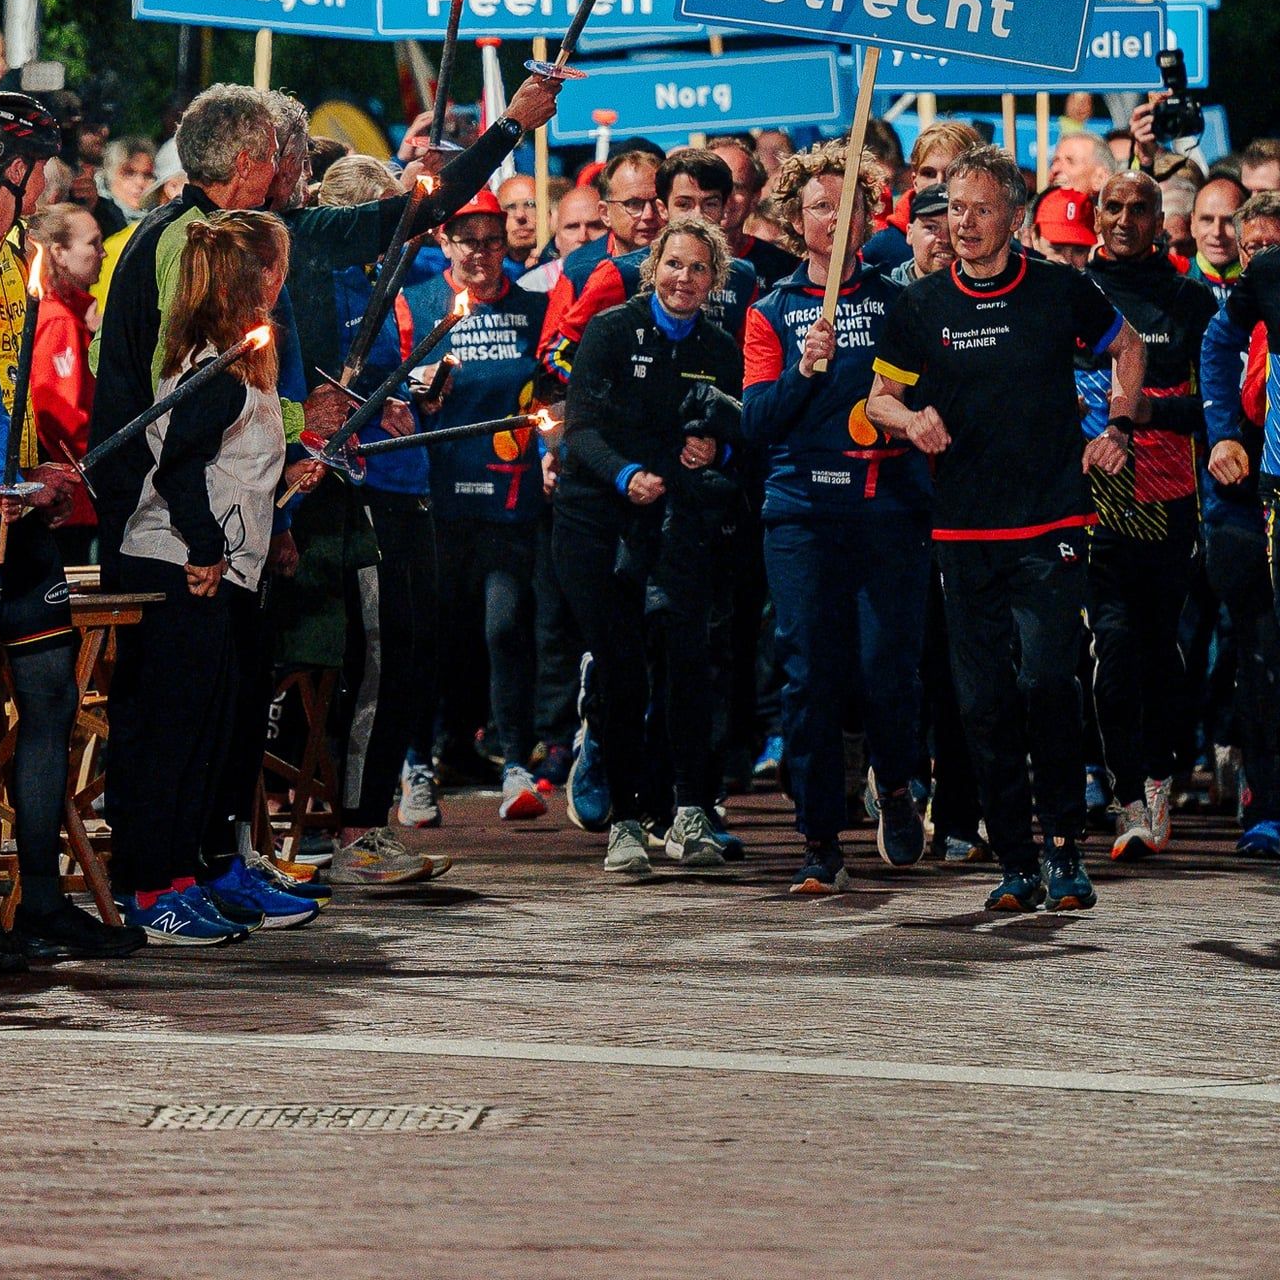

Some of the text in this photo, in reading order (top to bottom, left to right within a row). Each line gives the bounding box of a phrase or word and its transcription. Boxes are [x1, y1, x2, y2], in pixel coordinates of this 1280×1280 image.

[655, 82, 733, 113] Norg
[784, 305, 824, 327] UTRECH
[951, 325, 1010, 339] Utrecht Atletiek
[952, 337, 997, 351] TRAINER
[633, 364, 647, 379] NB
